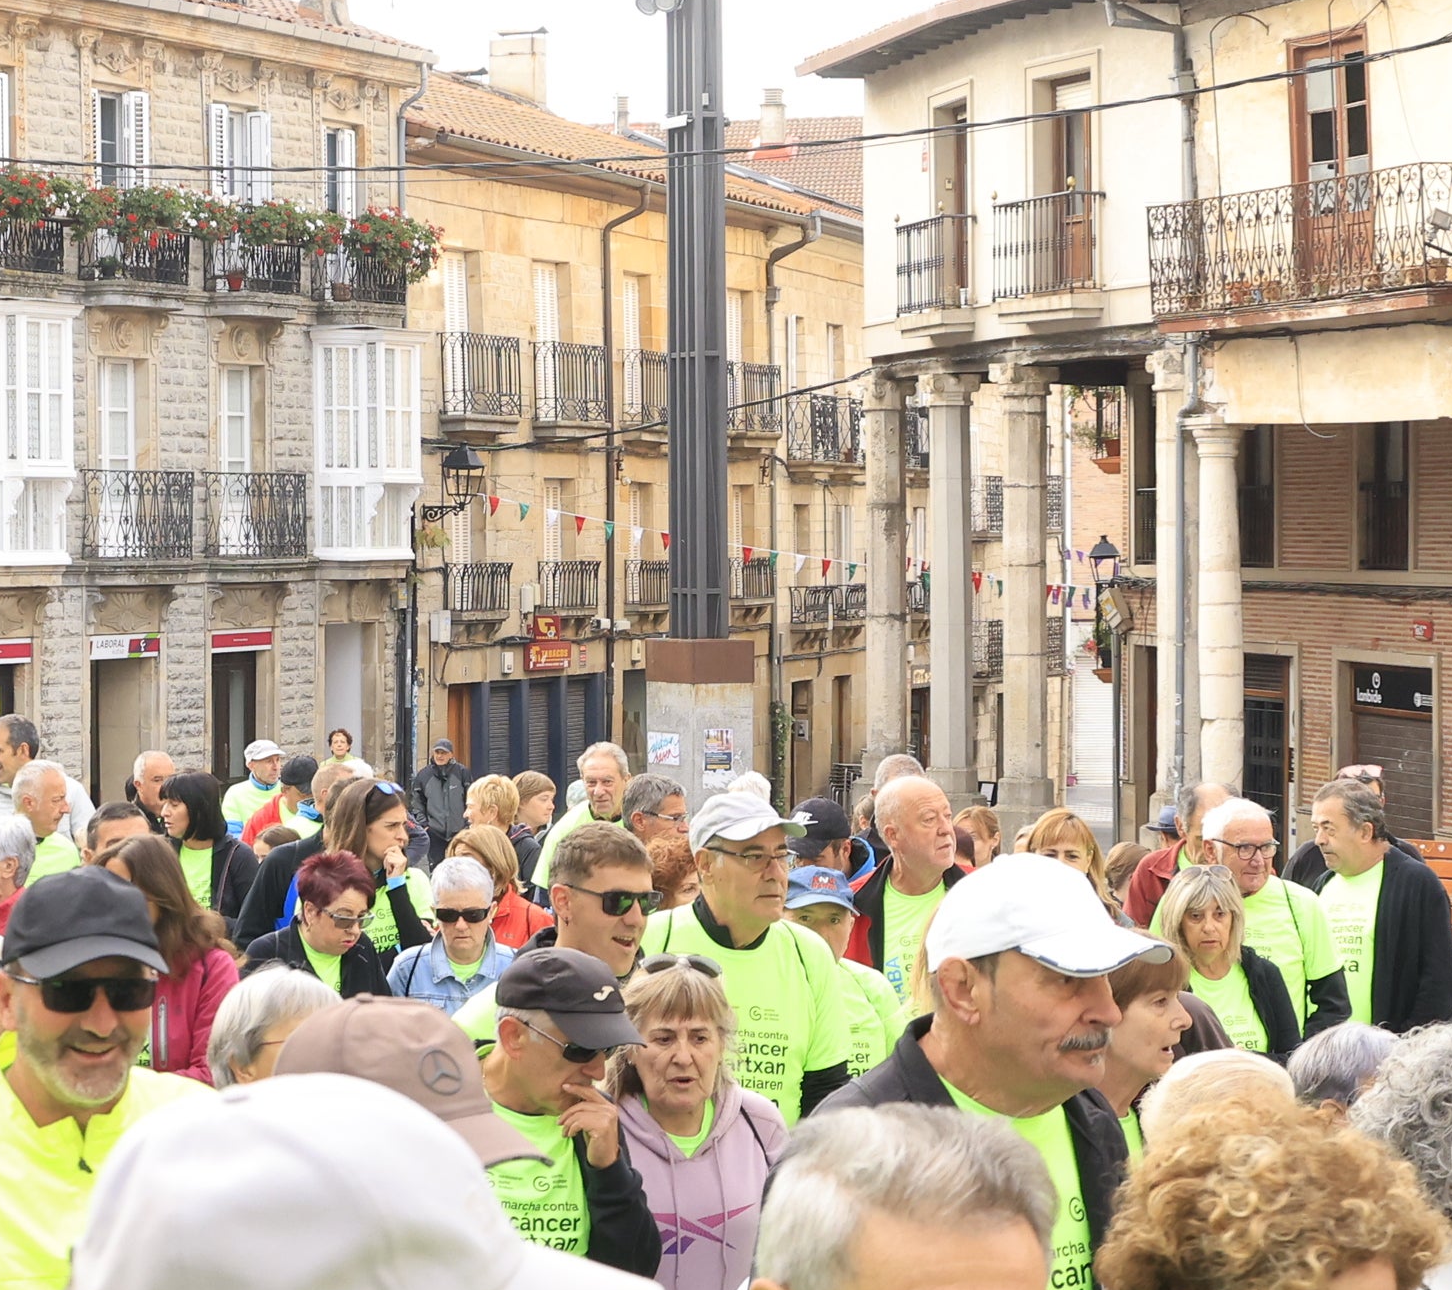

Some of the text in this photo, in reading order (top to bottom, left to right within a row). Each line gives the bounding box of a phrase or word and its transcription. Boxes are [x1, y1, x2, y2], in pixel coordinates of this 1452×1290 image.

[96, 639, 124, 649] LABORAL
[735, 1029, 789, 1041] rcha contra
[738, 1039, 789, 1057] áncer
[738, 1076, 783, 1090] iziaren
[501, 1200, 579, 1212] marcha contra
[510, 1212, 581, 1232] cáncer
[1054, 1241, 1086, 1259] rcha
